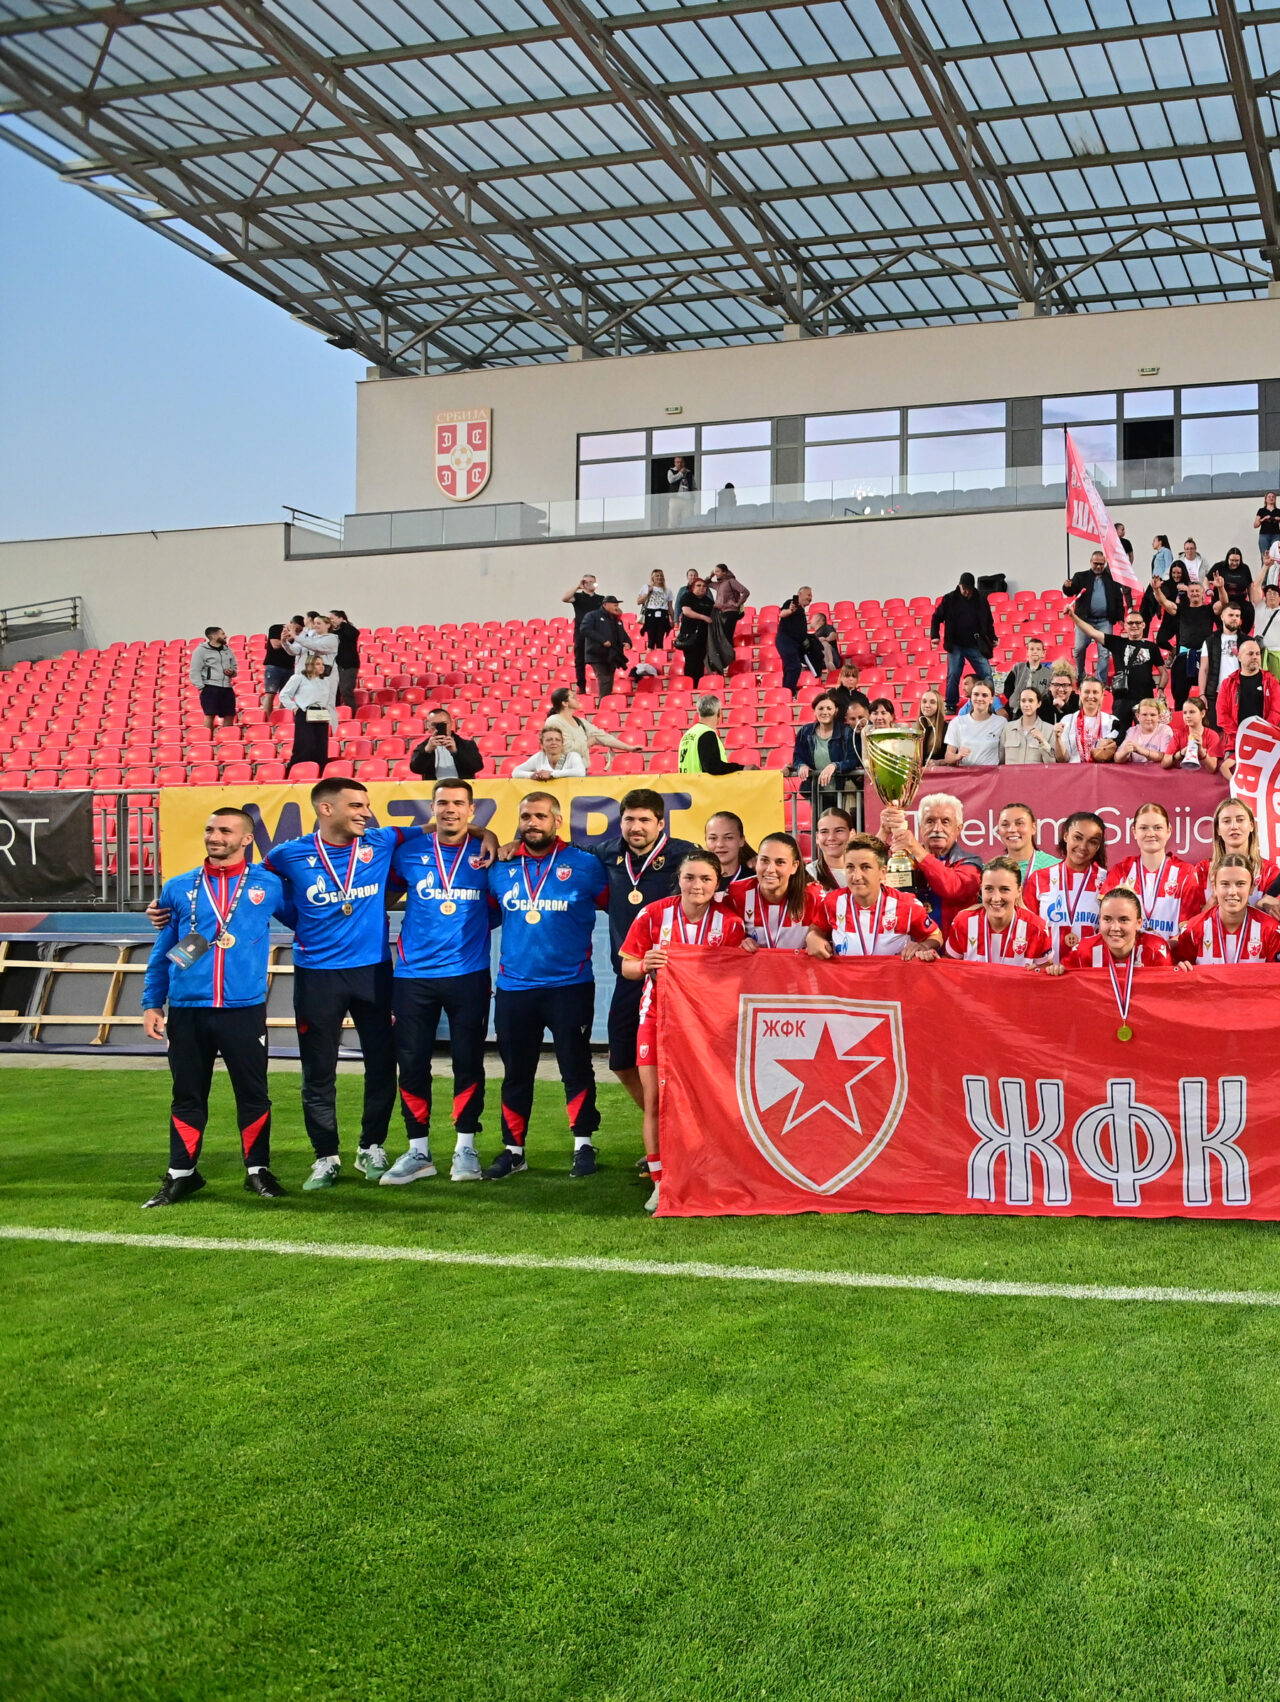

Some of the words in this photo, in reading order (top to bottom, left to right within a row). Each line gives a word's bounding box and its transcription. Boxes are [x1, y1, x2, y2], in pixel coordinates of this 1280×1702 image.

[1094, 806, 1215, 854] Srija
[762, 1019, 806, 1038] ЖФК
[962, 1075, 1252, 1206] ЖФК
